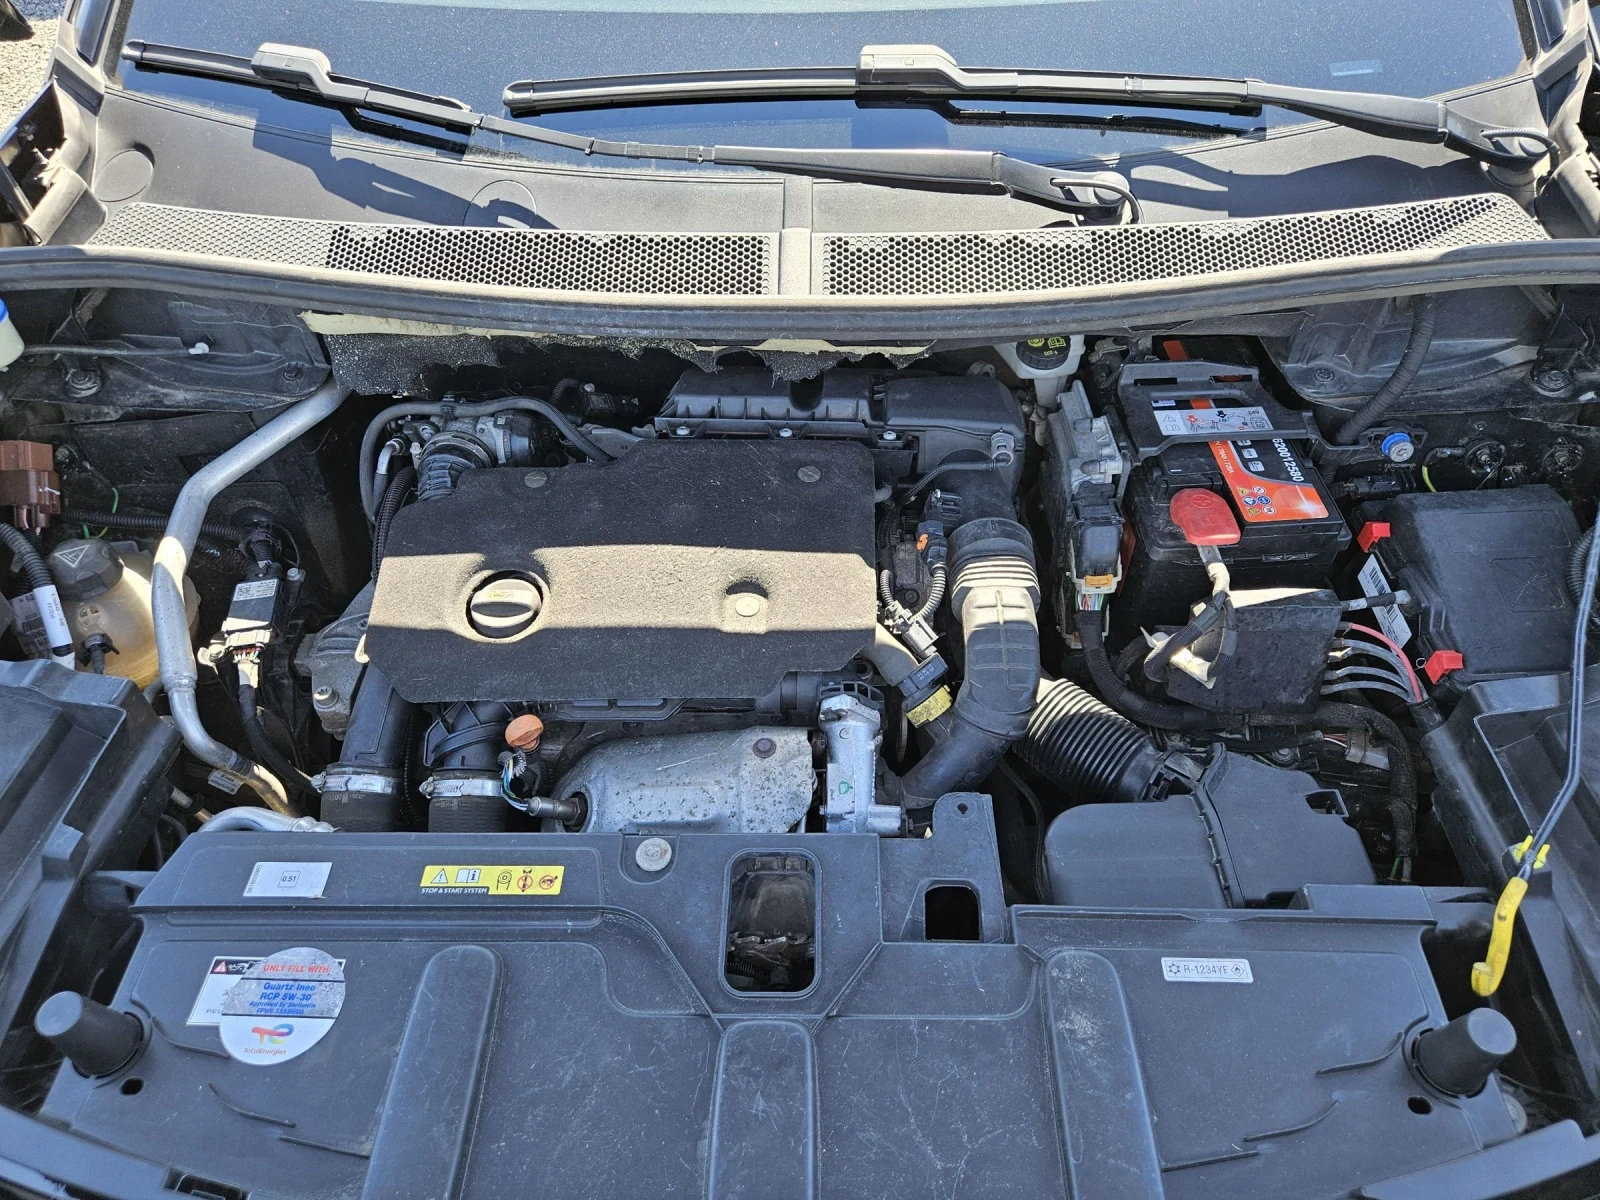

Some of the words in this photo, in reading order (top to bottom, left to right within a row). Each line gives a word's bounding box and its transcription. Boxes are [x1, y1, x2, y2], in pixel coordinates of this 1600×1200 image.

[1272, 438, 1304, 482] 620012580
[264, 982, 294, 991] Quartz
[296, 983, 316, 991] Ineo
